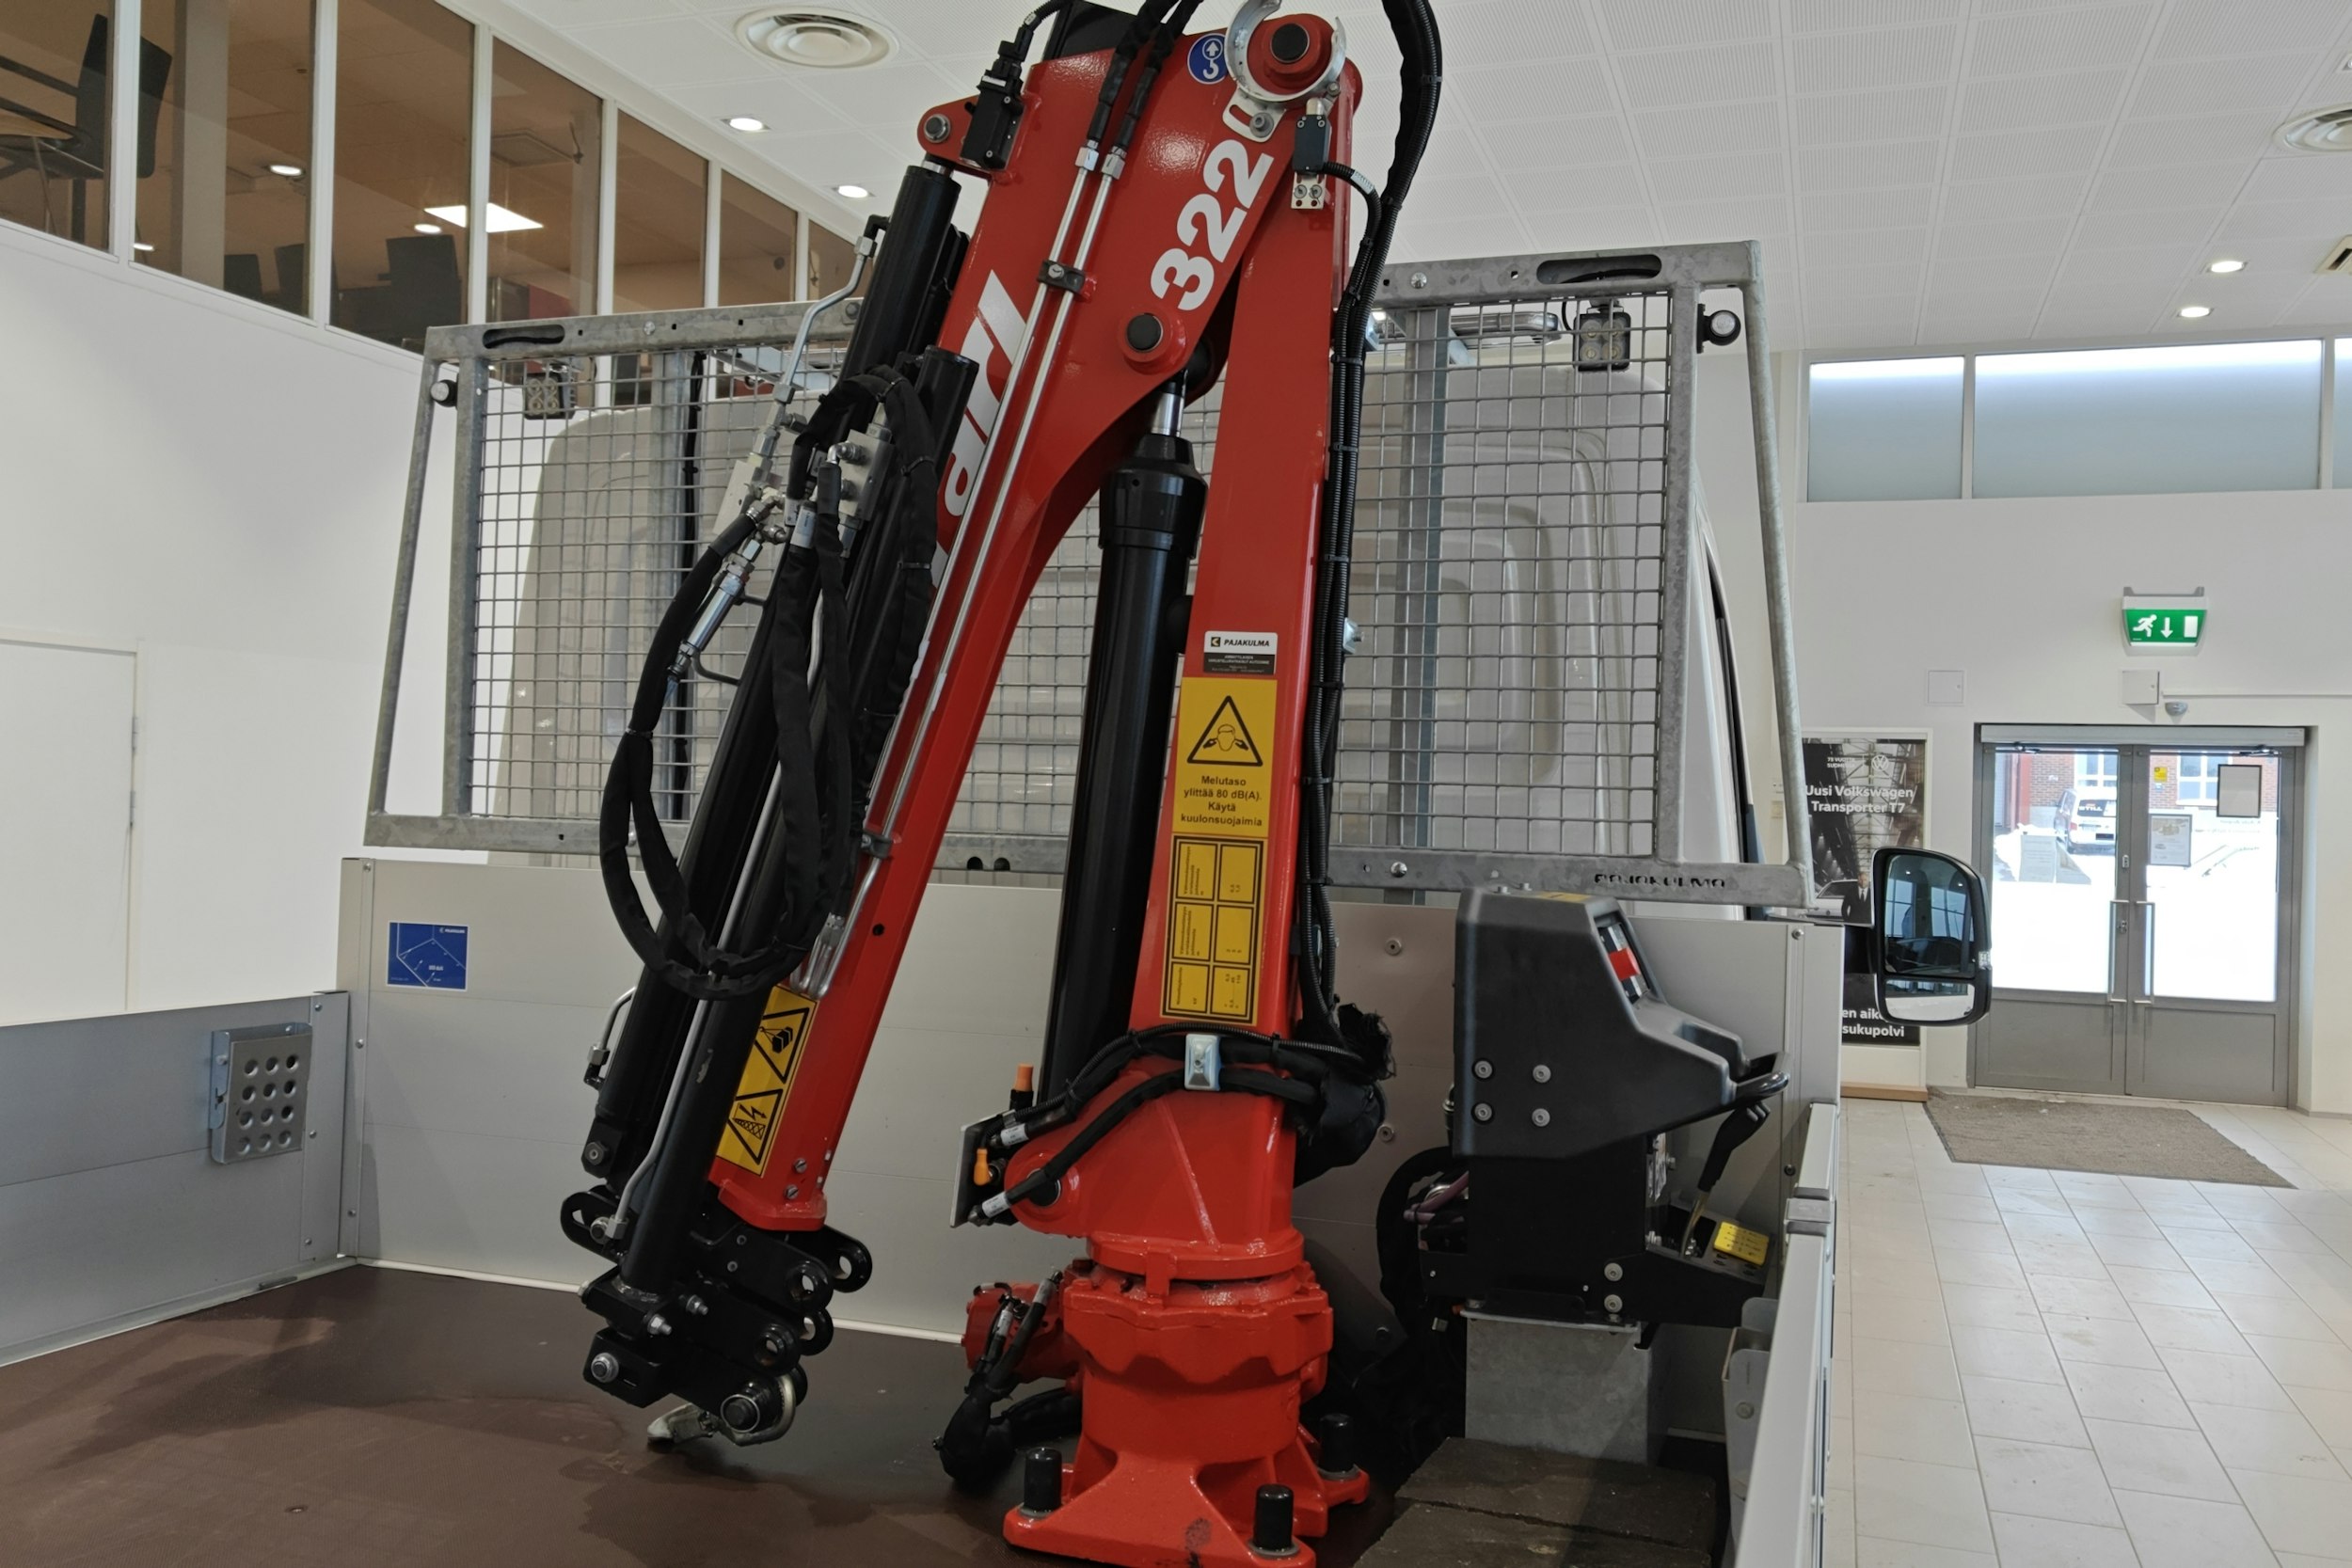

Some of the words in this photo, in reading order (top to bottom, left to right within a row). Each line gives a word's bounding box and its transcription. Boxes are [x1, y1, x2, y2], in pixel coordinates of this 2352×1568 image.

[1150, 139, 1275, 311] 322
[1223, 639, 1270, 647] PAJAKULMA
[1201, 775, 1247, 786] Melutaso
[1184, 787, 1214, 799] ylittää
[1216, 789, 1229, 799] 80
[1805, 784, 1833, 797] Uusi
[1835, 785, 1914, 799] Volkswagen
[1208, 801, 1236, 813] Käytä
[1811, 800, 1885, 814] Transporter
[1888, 802, 1906, 814] T7
[1181, 814, 1263, 827] kuulonsuojaimia
[1842, 1023, 1905, 1038] sukupolvi
